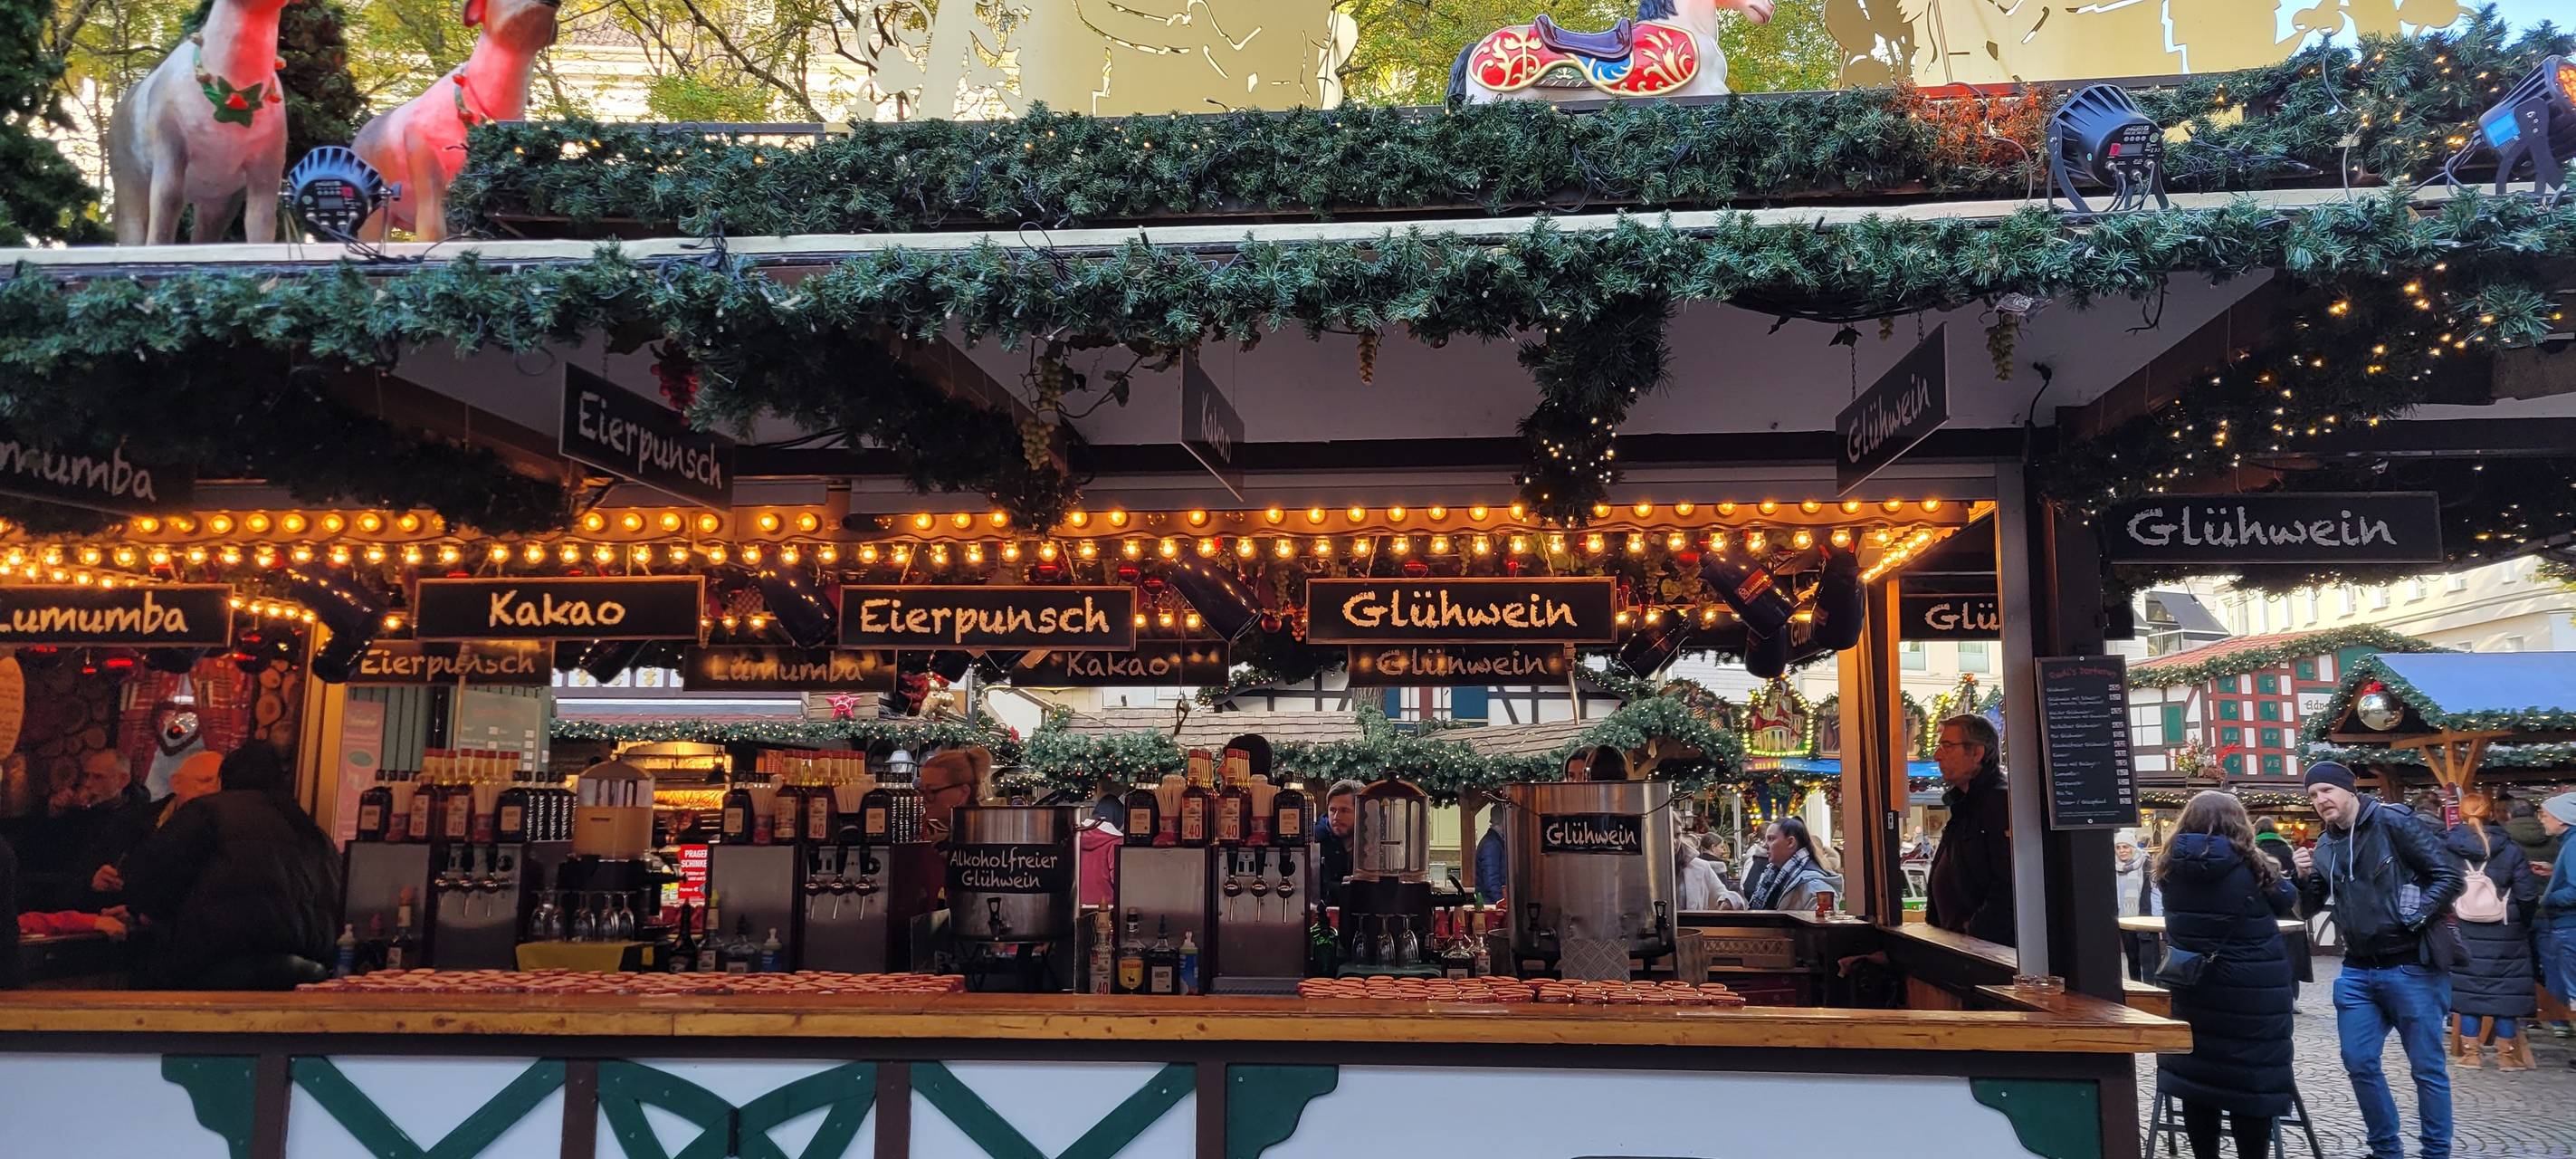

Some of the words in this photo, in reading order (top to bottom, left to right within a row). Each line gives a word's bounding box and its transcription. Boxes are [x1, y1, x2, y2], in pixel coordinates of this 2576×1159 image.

[1201, 391, 1232, 465] Kakao
[1847, 372, 1931, 464] Glühwein
[578, 391, 722, 490] Eierpunsch
[2126, 505, 2398, 546] Glühwein
[489, 589, 626, 627] Kakao
[860, 596, 1110, 644] Eierpunsch
[1342, 589, 1578, 629] Glühwein
[361, 653, 536, 677] Eierpunsch
[711, 650, 863, 683] Lumumba
[1066, 651, 1171, 678] Kakao
[1376, 648, 1547, 676] Glühwein
[1188, 825, 1201, 838] 40
[1226, 825, 1237, 838] 40
[1547, 820, 1636, 846] Glühwein
[949, 846, 1058, 872] Alkoholfreier
[961, 870, 1042, 889] Glühwein
